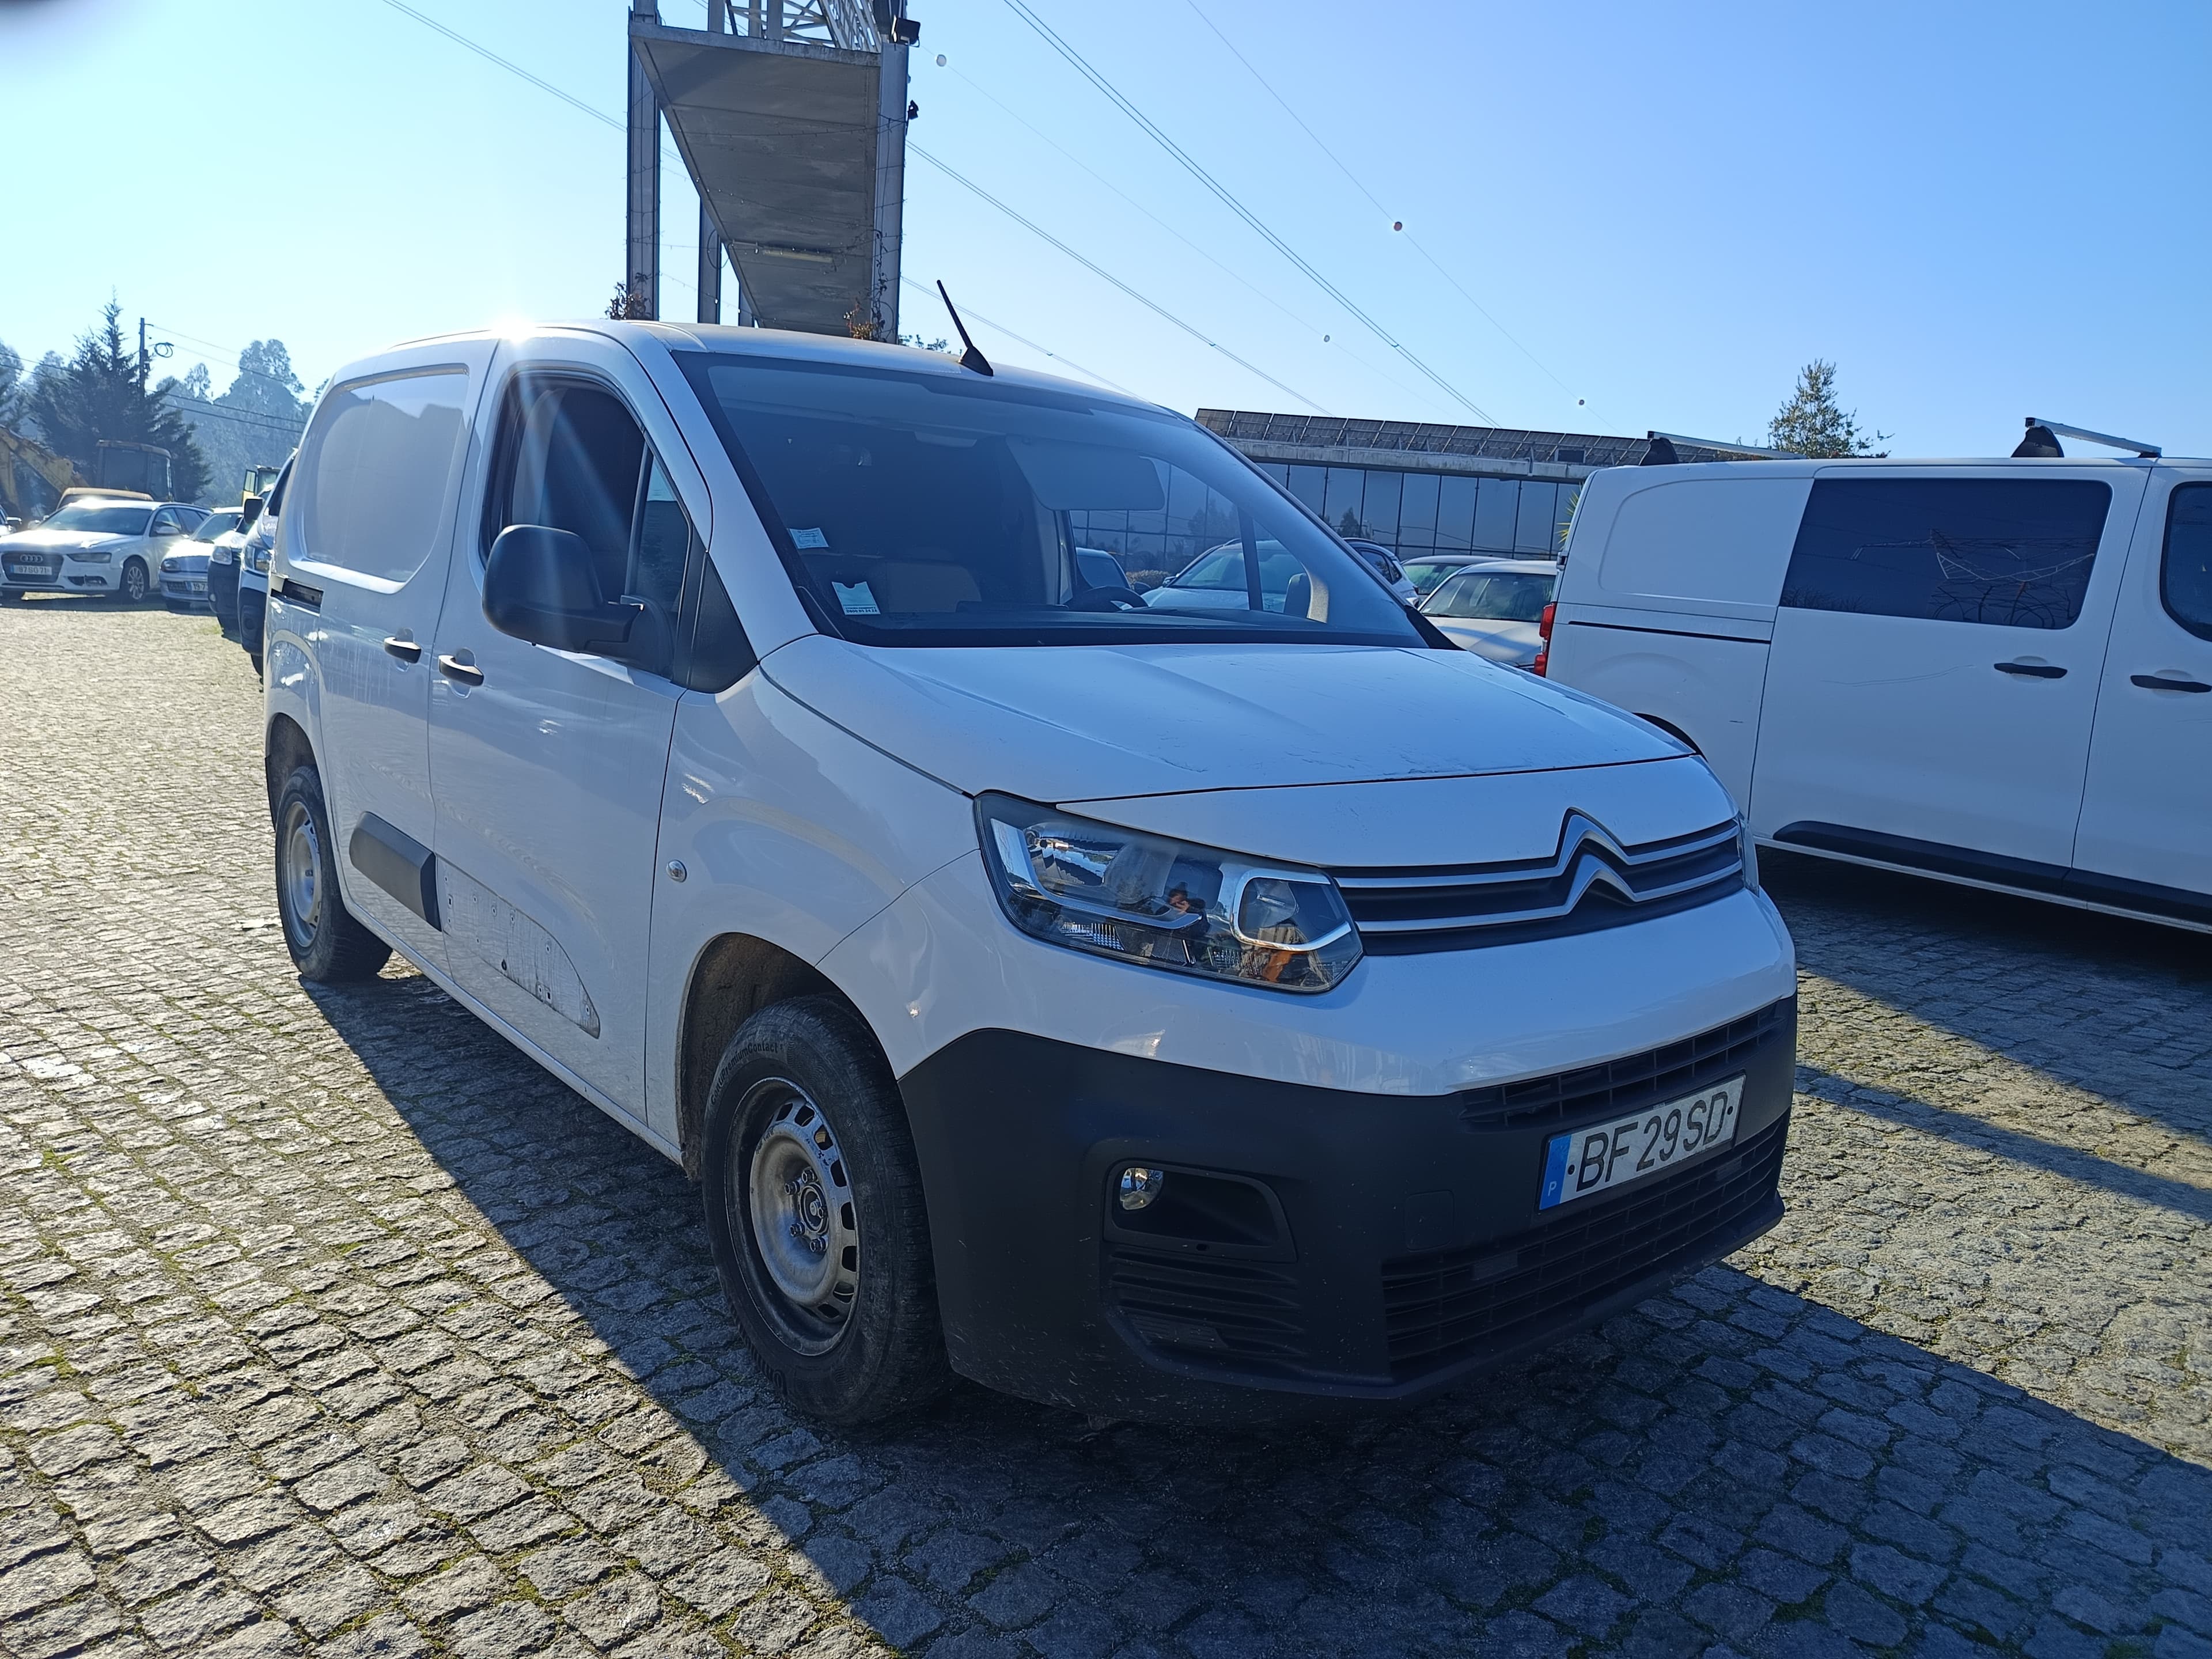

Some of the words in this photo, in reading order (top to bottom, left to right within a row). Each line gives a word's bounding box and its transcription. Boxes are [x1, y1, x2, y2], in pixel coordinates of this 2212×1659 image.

[1576, 1122, 1639, 1192] BF
[1636, 1109, 1681, 1172] 29
[1683, 1091, 1728, 1152] SD
[1547, 1180, 1557, 1196] P
